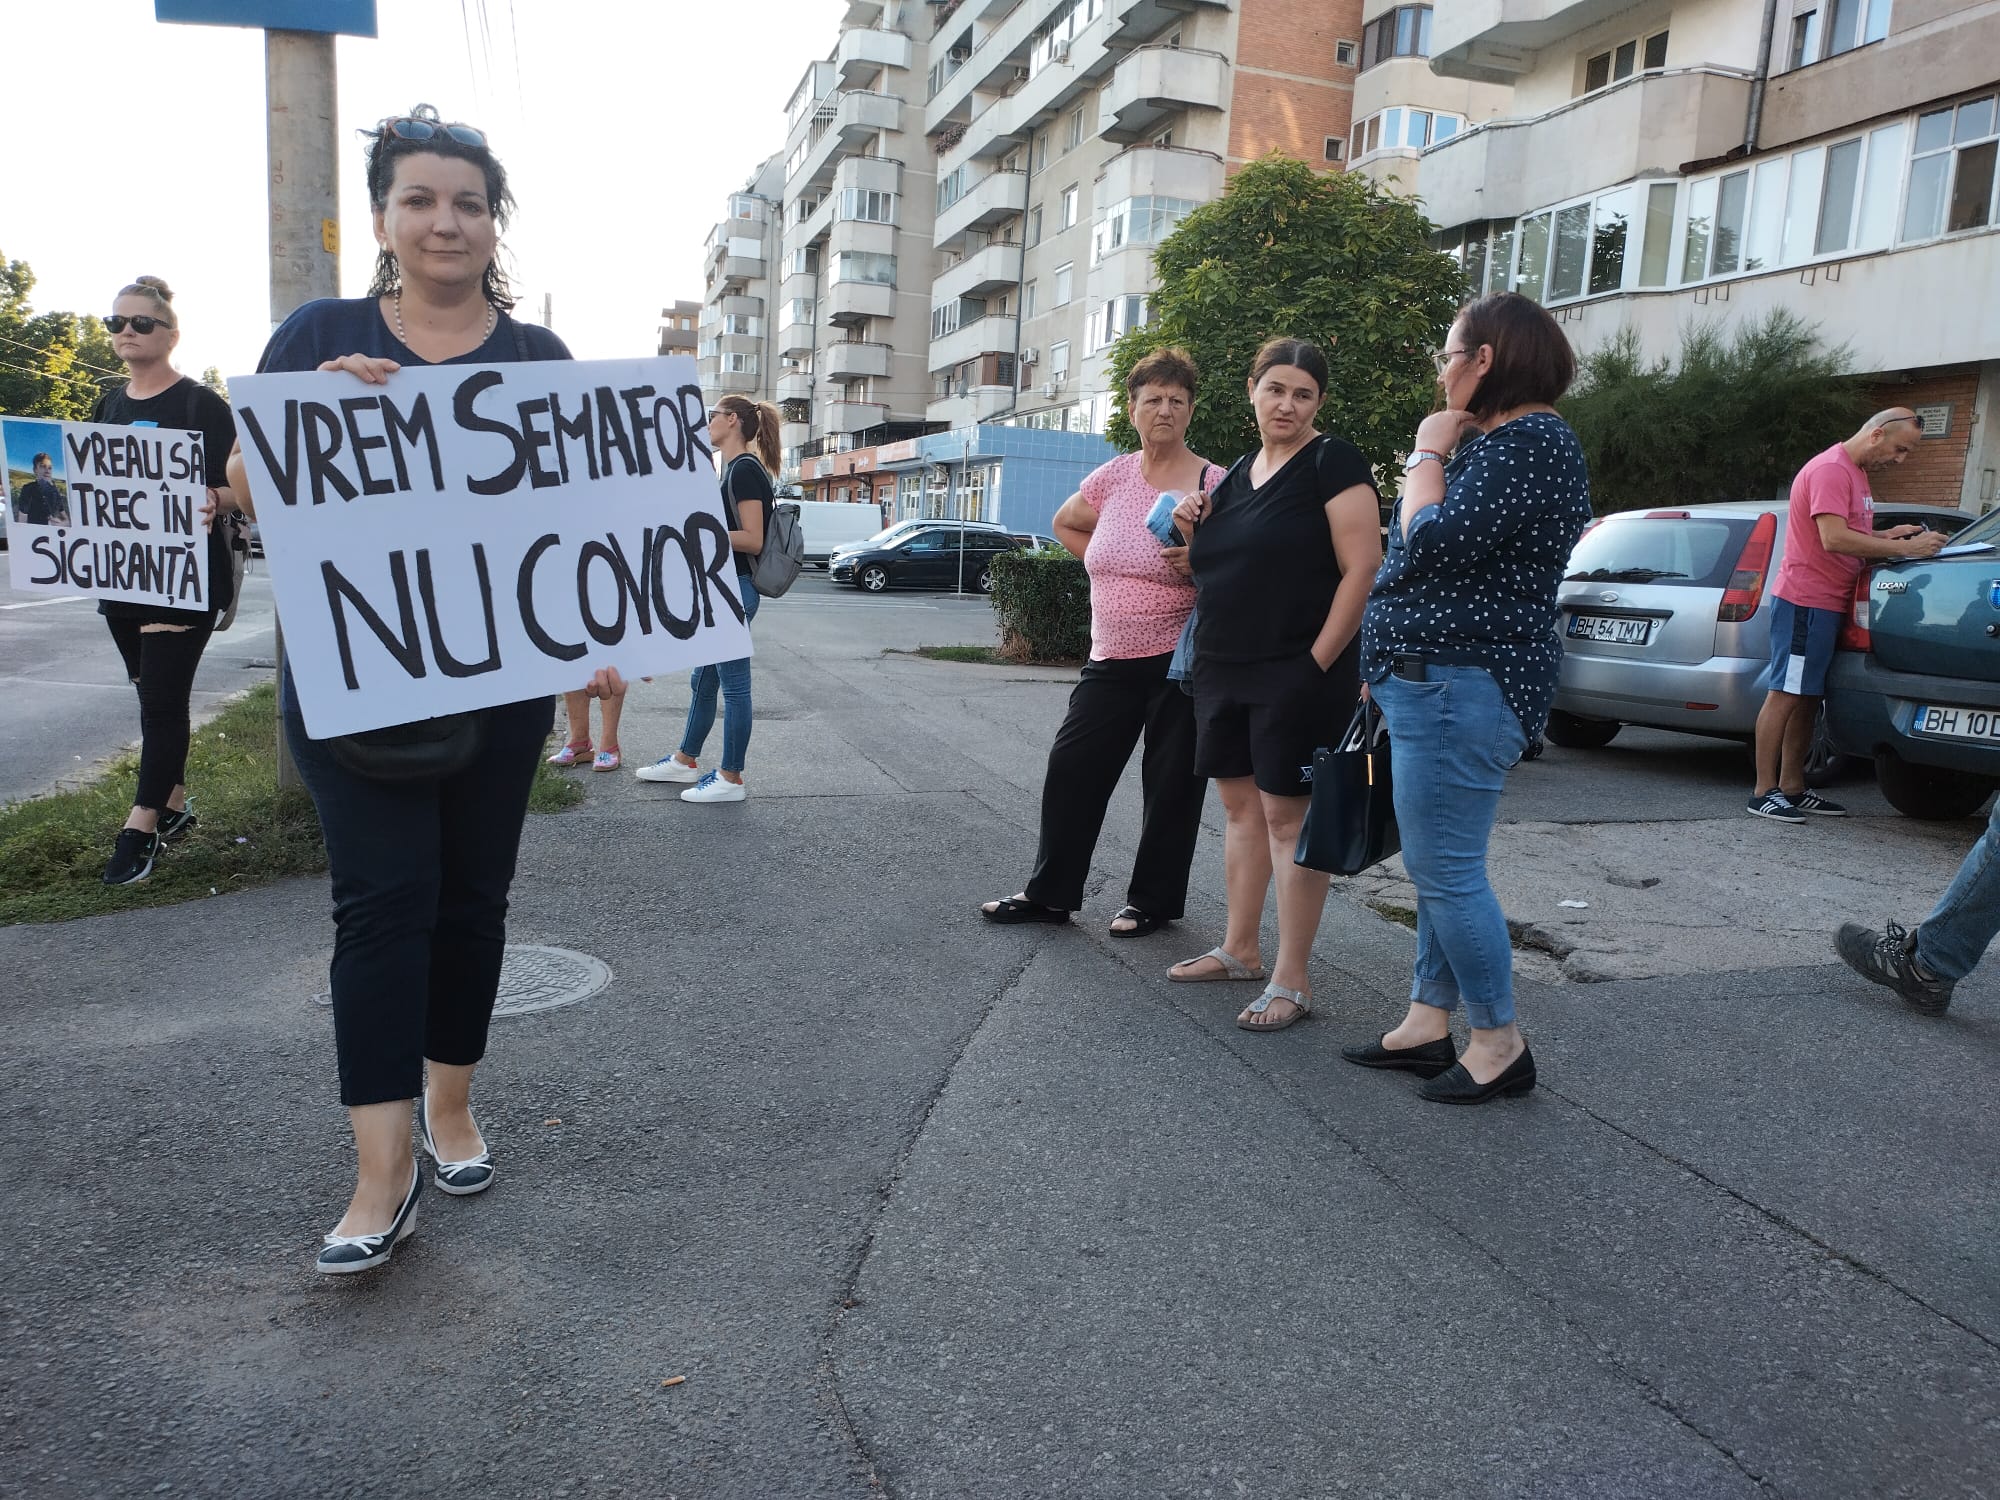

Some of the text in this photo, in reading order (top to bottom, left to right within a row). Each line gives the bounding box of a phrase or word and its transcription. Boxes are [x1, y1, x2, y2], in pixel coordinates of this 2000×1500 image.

[67, 431, 205, 485] VREAU SĂ
[238, 371, 716, 506] VREM SEMAFOR
[72, 481, 193, 536] TREC ÎN
[321, 511, 748, 691] NU COVOR
[1876, 581, 1908, 591] LOGAN
[1575, 618, 1597, 634] BH
[1597, 619, 1616, 637] 54
[1617, 621, 1647, 639] TMY
[1924, 709, 1959, 733] BH
[1966, 712, 1988, 736] 10
